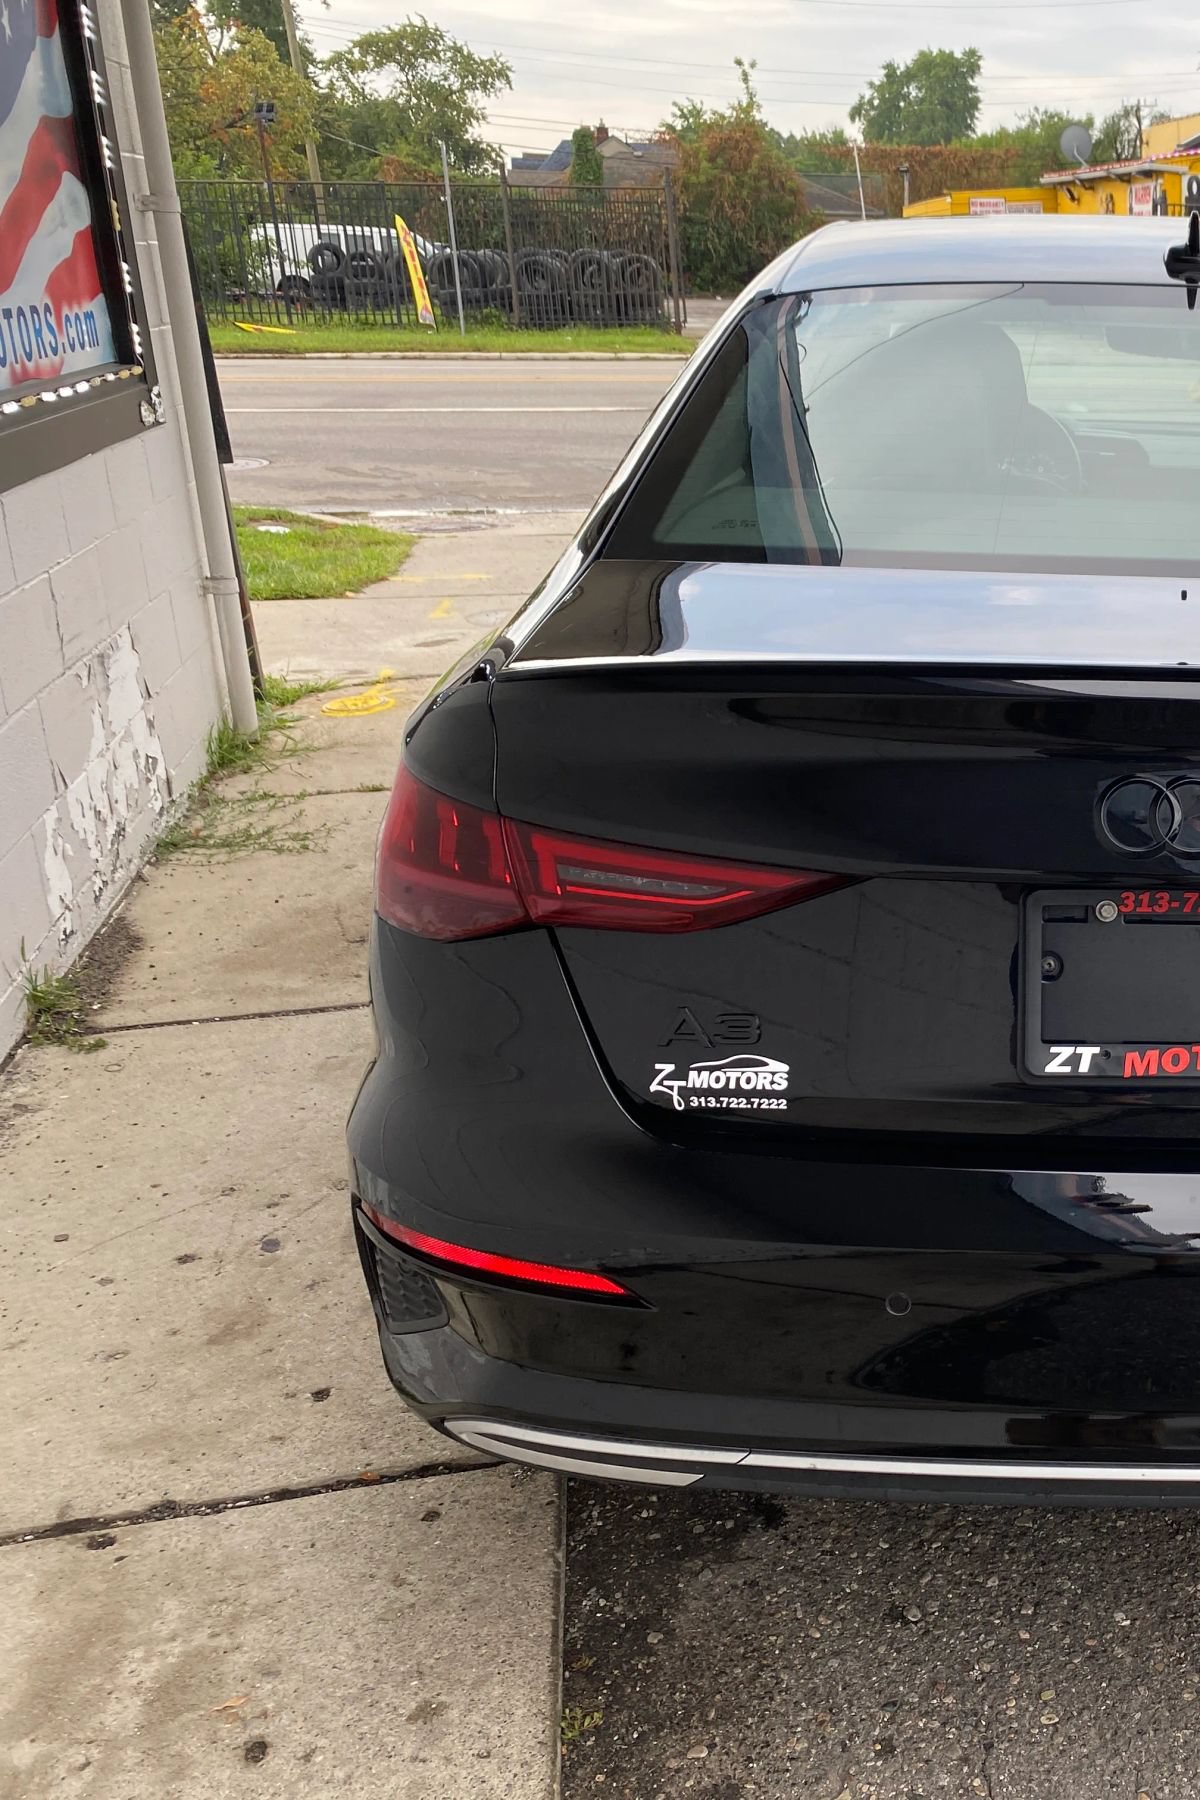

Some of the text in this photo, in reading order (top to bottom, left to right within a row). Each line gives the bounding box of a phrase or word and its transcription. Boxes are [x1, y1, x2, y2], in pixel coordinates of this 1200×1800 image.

[657, 1006, 762, 1048] A3
[1044, 1046, 1100, 1073] ZT
[686, 1070, 788, 1091] MOTORS
[689, 1096, 788, 1110] 313.722.7222
